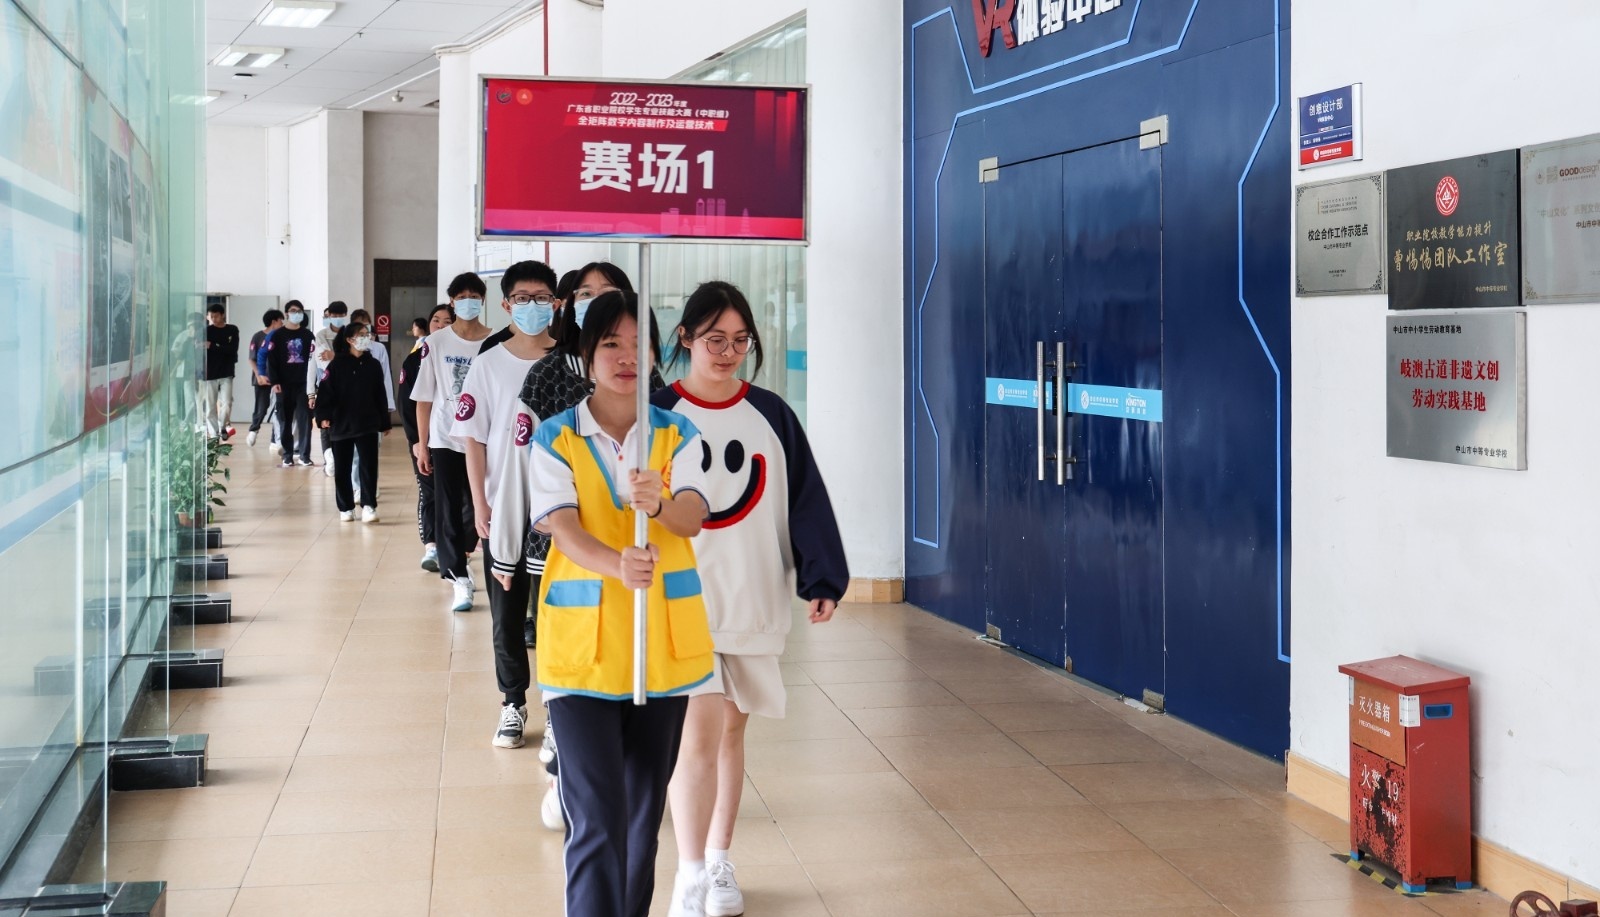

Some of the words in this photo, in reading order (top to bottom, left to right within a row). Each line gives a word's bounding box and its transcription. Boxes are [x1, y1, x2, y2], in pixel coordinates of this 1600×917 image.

[1309, 98, 1343, 116] 创意设计部
[1308, 224, 1368, 241] 校企合作工作示范点
[1406, 220, 1492, 242] 职业院校教学能力提升
[1393, 325, 1462, 334] 中山市中小学生劳动教育基地
[1400, 358, 1499, 381] 岐澳古道非遗文创
[1412, 388, 1487, 412] 劳动实践基地
[1455, 445, 1507, 458] 中山市中等专业学校
[1359, 695, 1391, 723] 灭火器箱
